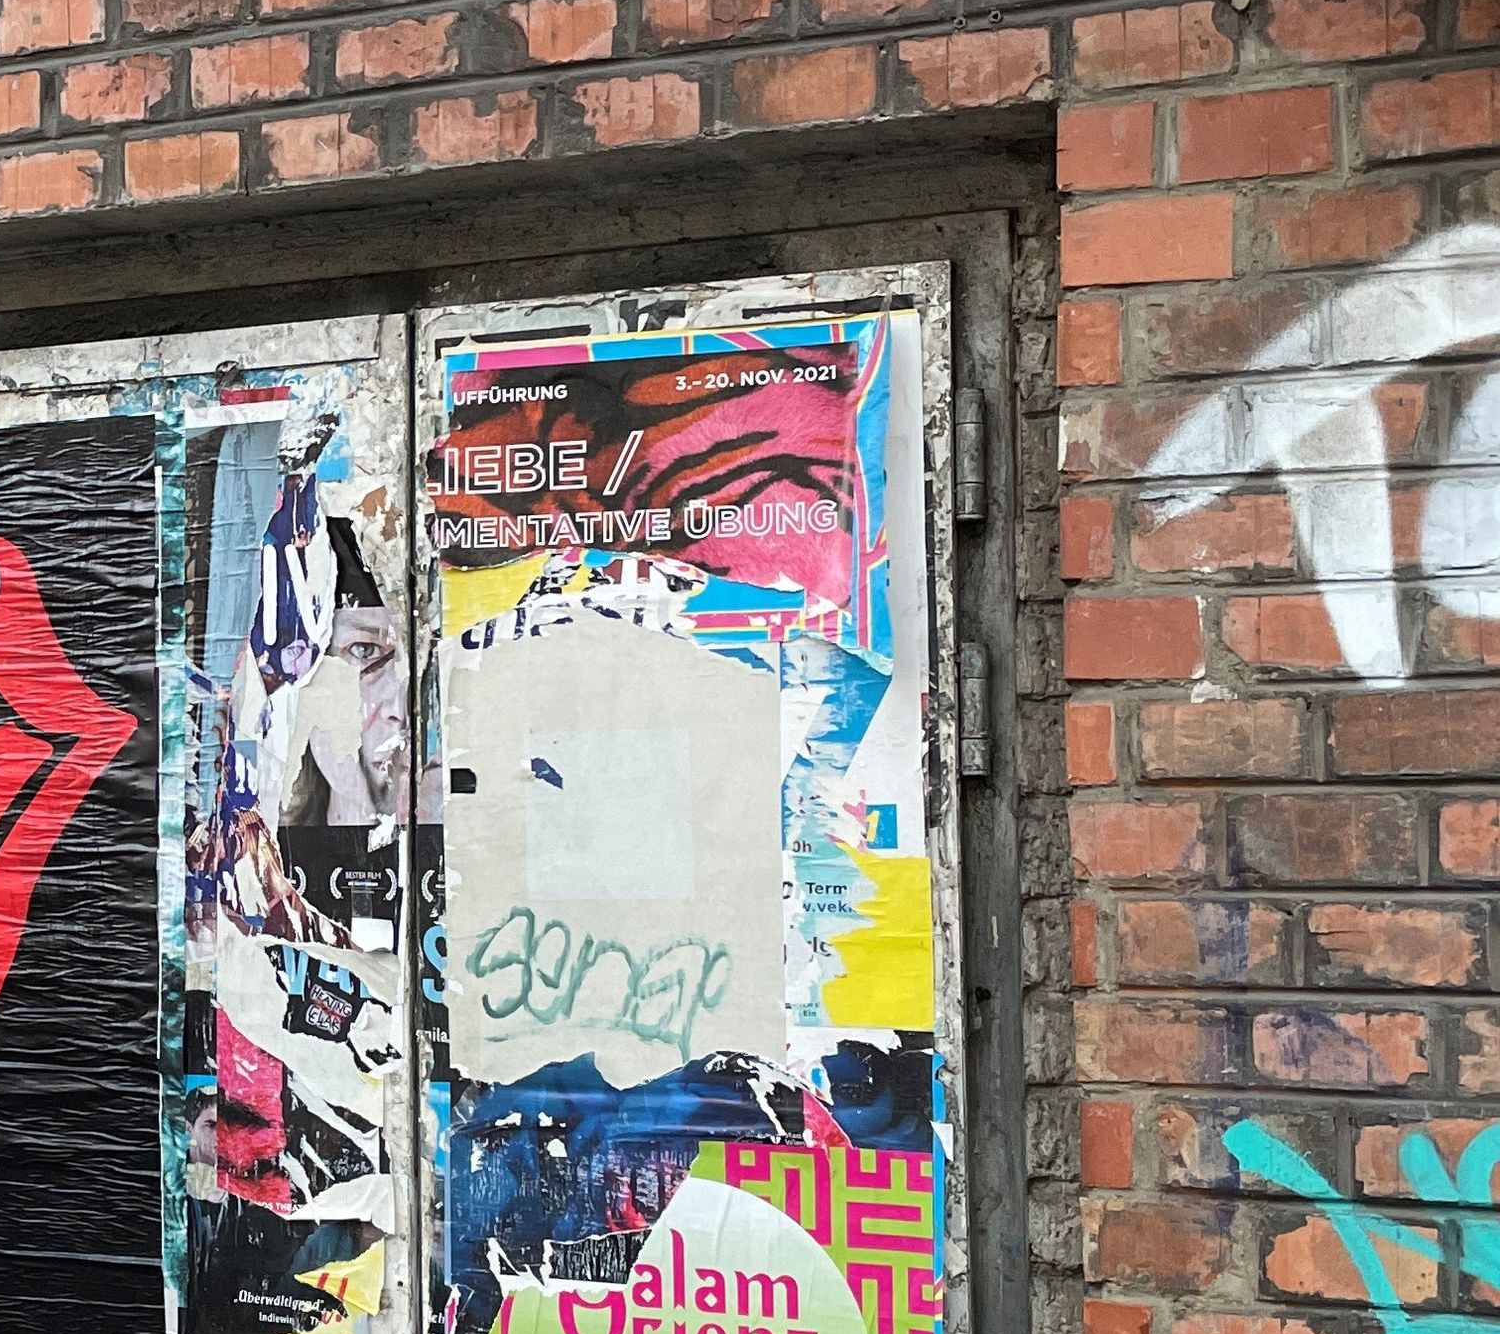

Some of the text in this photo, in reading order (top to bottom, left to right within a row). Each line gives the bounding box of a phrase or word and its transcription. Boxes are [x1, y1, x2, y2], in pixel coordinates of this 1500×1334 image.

[740, 369, 786, 386] NOV.
[793, 365, 837, 383] 2021
[427, 440, 587, 496] IEBE
[434, 499, 838, 549] MENTATIVE ÜBUNG
